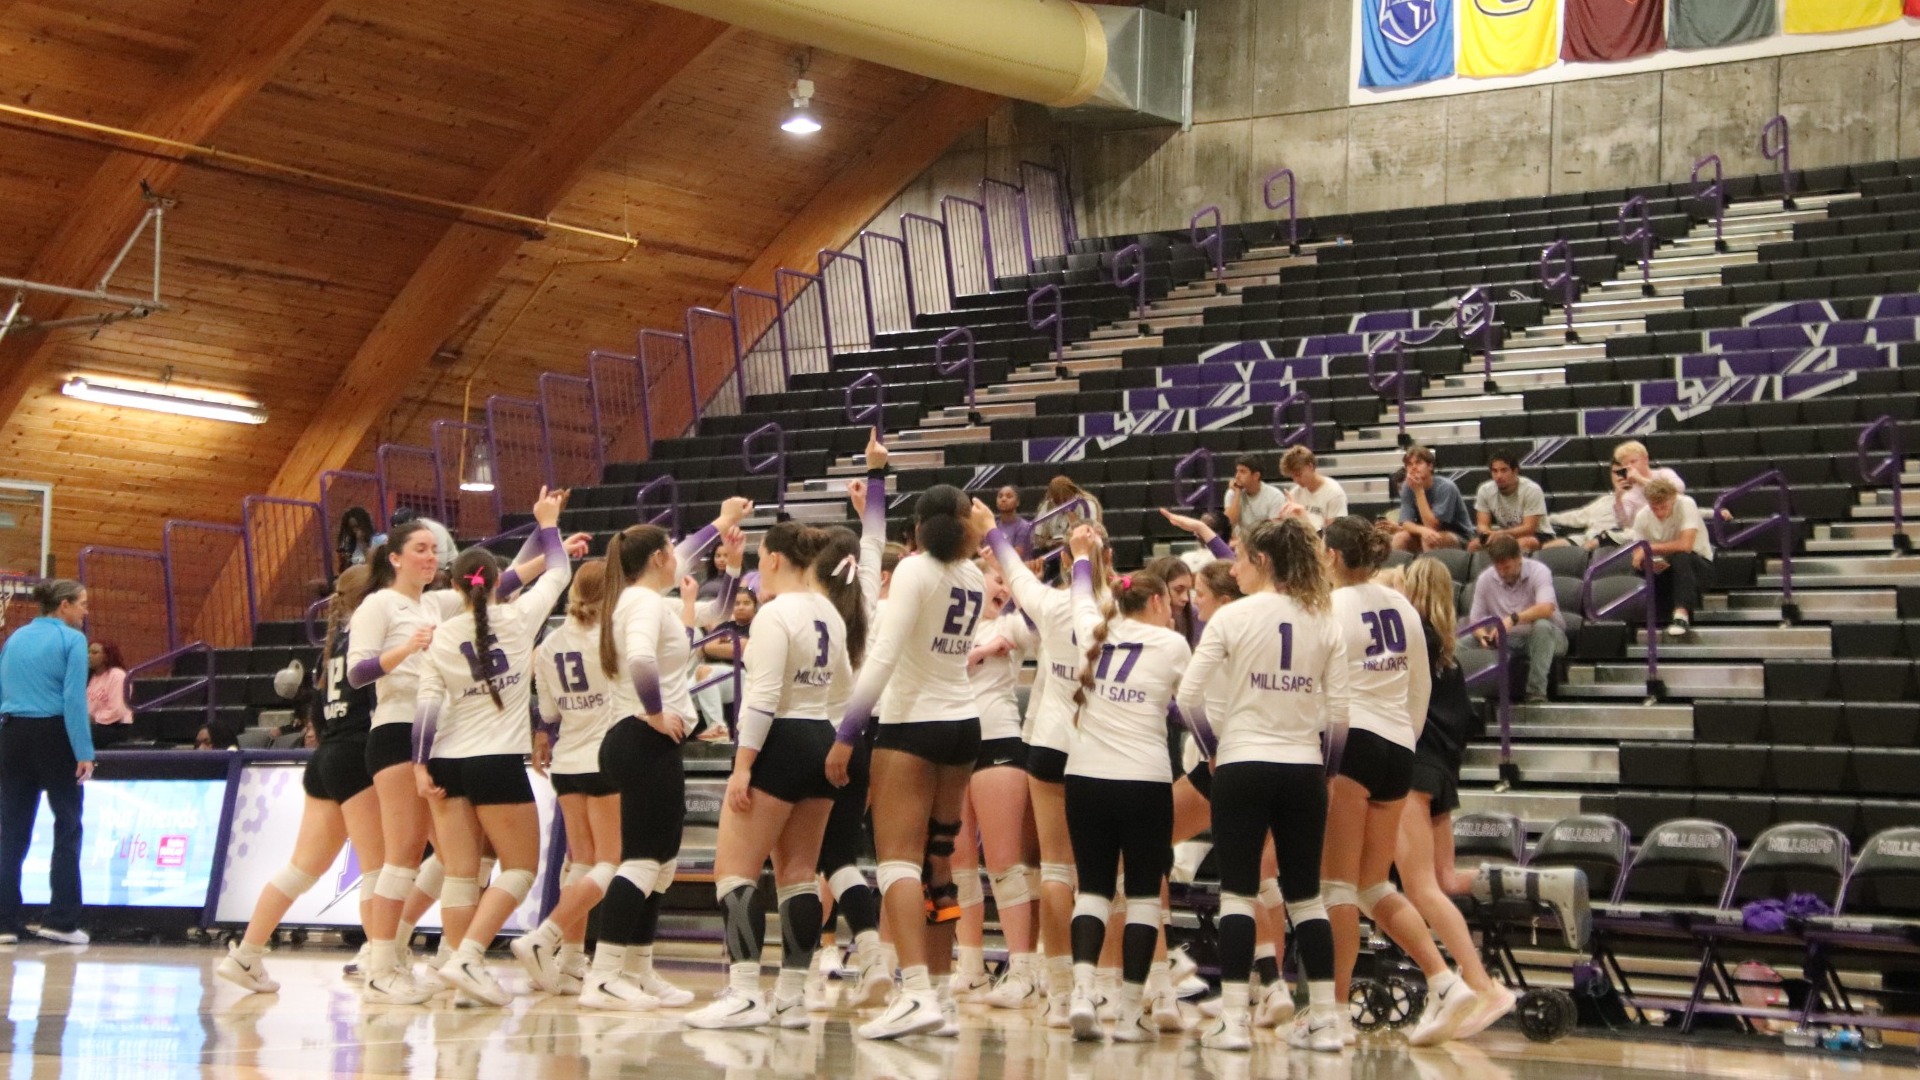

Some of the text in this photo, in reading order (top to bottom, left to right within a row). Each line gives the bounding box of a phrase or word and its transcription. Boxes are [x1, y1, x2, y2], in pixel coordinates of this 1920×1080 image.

[943, 587, 982, 636] 27
[1361, 609, 1407, 656] 30
[814, 620, 829, 667] 3
[931, 637, 974, 656] MILLSAP
[1279, 622, 1293, 671] 1
[554, 651, 589, 693] 13
[1052, 662, 1078, 682] MILL
[1095, 642, 1143, 683] 17
[1250, 673, 1313, 694] MILLSAPS
[555, 693, 604, 711] MILLSAPS
[1554, 827, 1615, 843] MILLSAPS
[1657, 831, 1721, 849] MILLSAPS
[1767, 837, 1834, 854] MILLSAPS
[1877, 839, 1920, 858] MILLS
